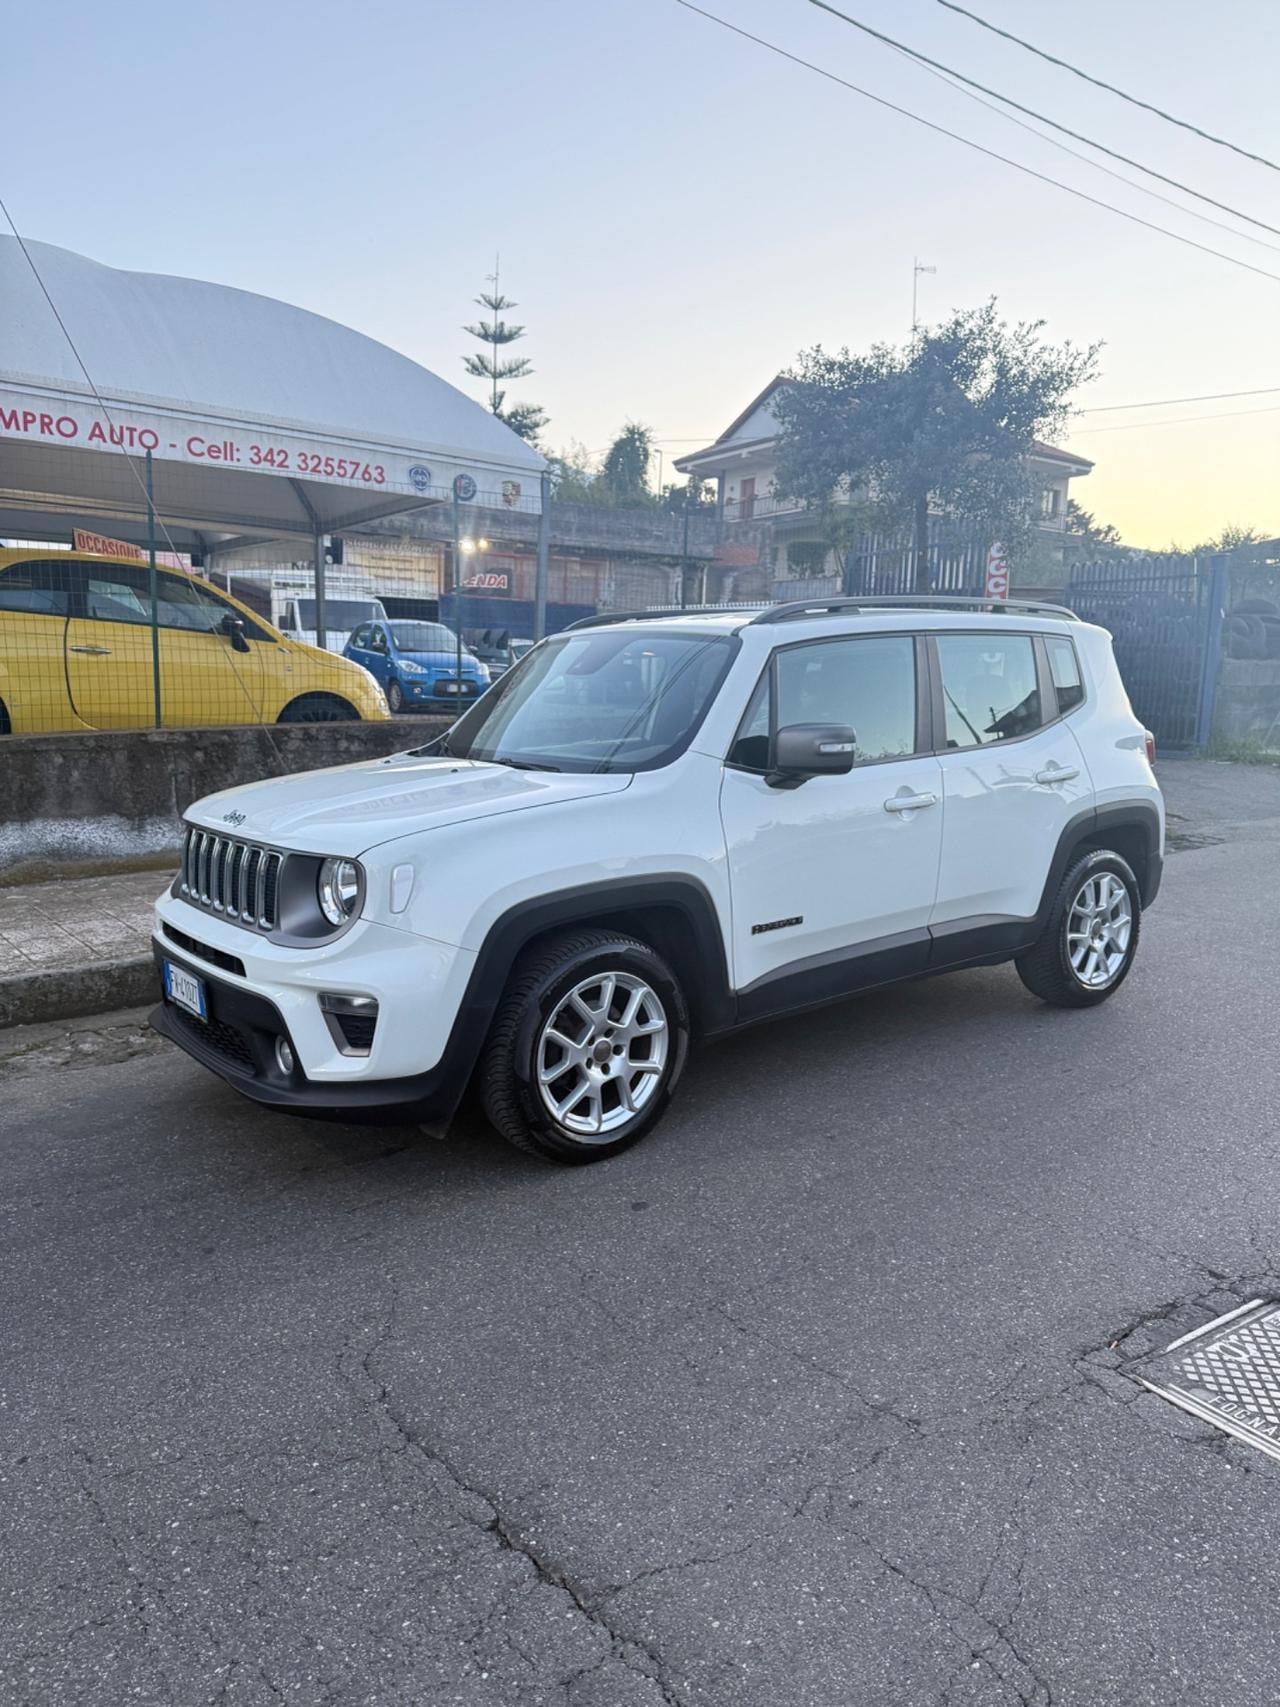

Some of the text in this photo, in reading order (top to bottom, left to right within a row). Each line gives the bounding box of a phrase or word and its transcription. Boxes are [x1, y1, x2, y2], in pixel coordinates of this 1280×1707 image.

[88, 421, 159, 450] AUTO
[187, 436, 241, 463] Cell:
[249, 445, 289, 469] 342
[297, 452, 385, 484] 3255763
[1207, 1395, 1280, 1441] FOGNA
